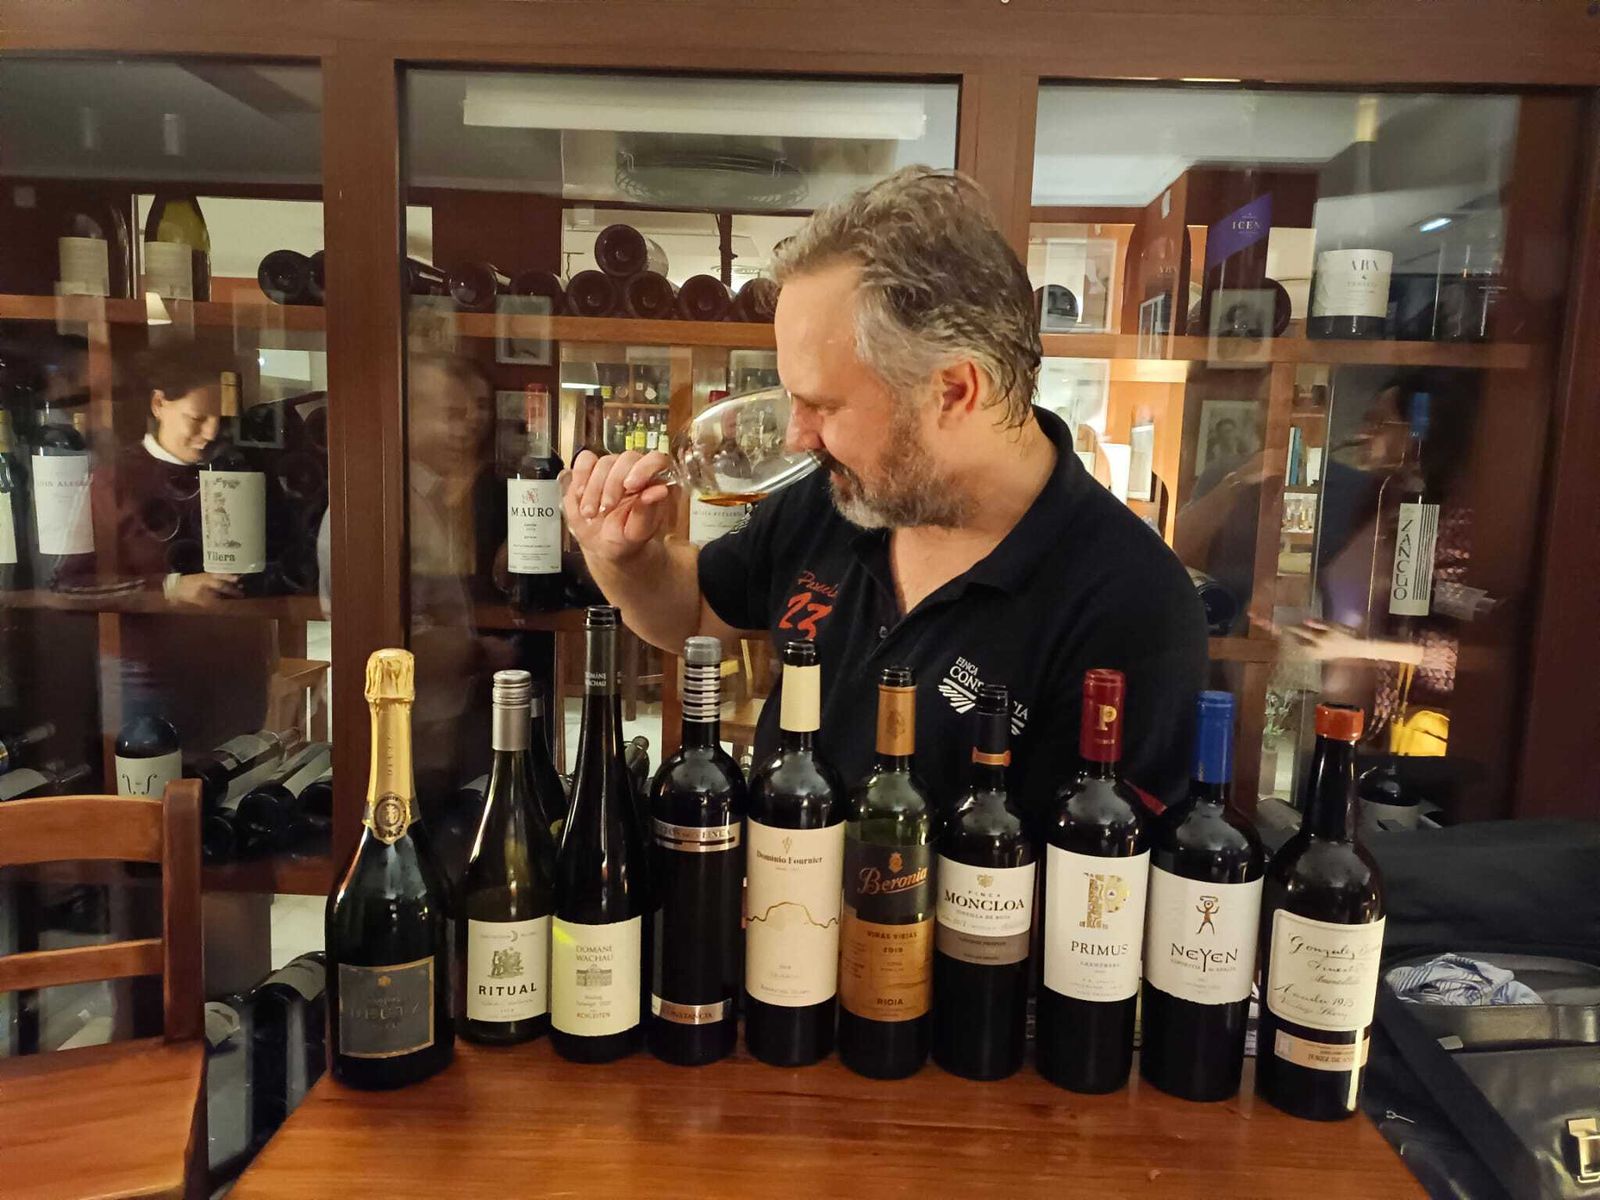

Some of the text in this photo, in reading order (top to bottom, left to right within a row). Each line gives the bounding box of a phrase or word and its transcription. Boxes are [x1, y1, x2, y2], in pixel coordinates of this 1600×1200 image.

[511, 507, 555, 518] MAURO
[779, 592, 833, 641] 23
[955, 656, 979, 676] FINCA
[857, 866, 928, 895] Beronia
[944, 889, 1025, 911] MONCLOA
[1071, 940, 1128, 956] PRIMUS
[576, 953, 613, 962] WACHAU
[478, 982, 537, 996] RITUAL
